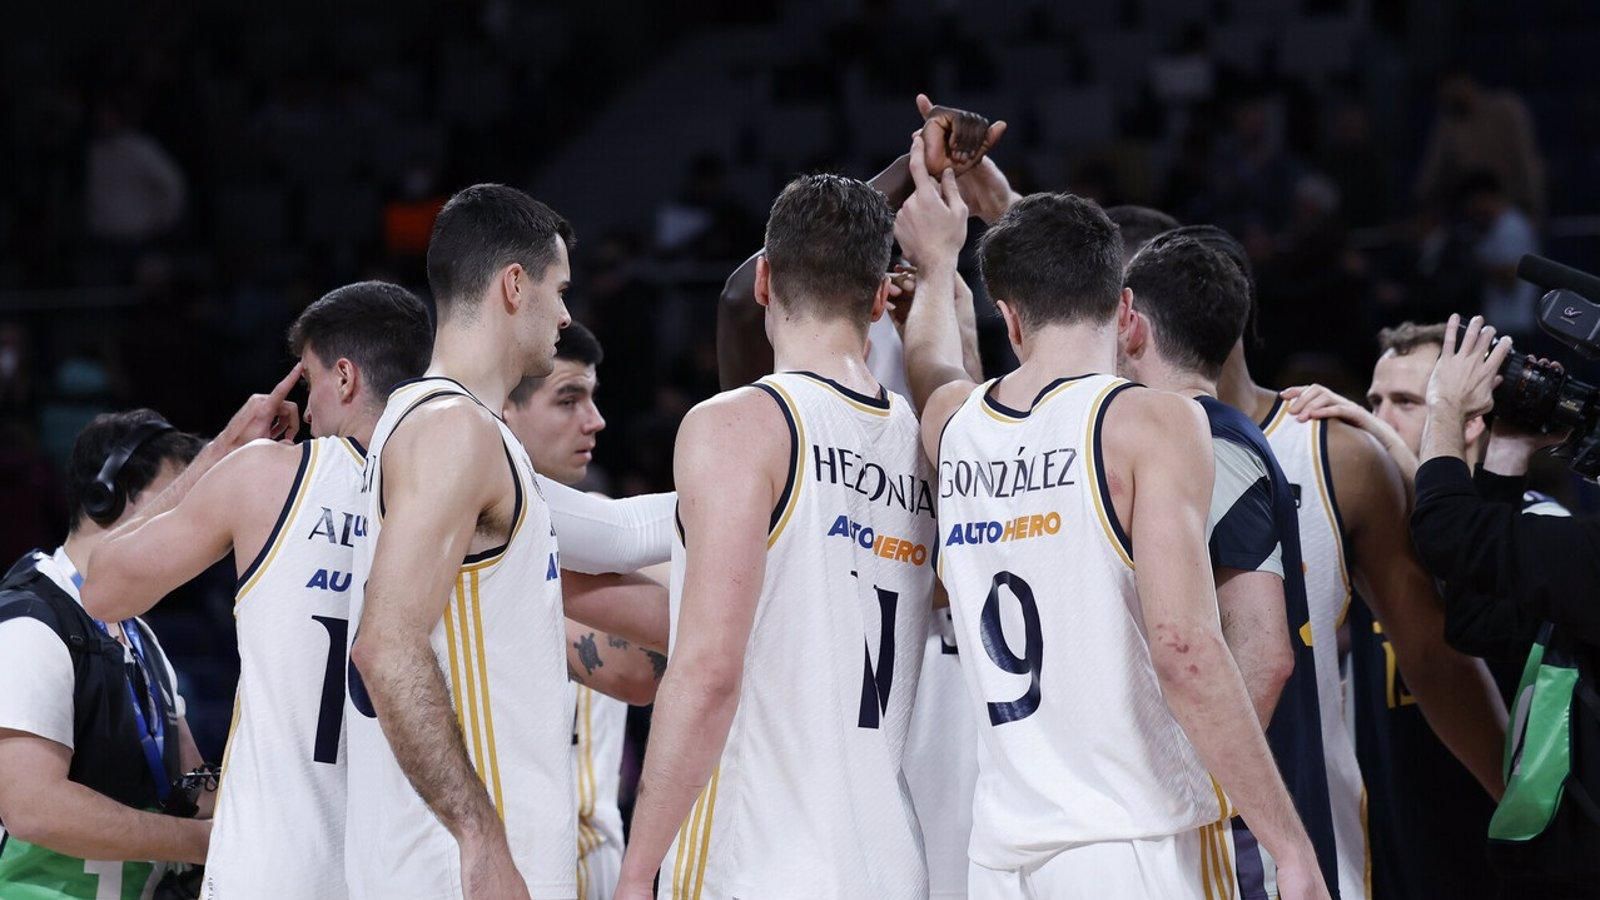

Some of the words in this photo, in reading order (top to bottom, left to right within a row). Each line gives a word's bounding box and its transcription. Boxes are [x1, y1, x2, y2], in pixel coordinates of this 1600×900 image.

[940, 446, 1077, 498] GONZÁLEZ
[945, 511, 1061, 547] AUTOHERO
[979, 570, 1044, 727] 9
